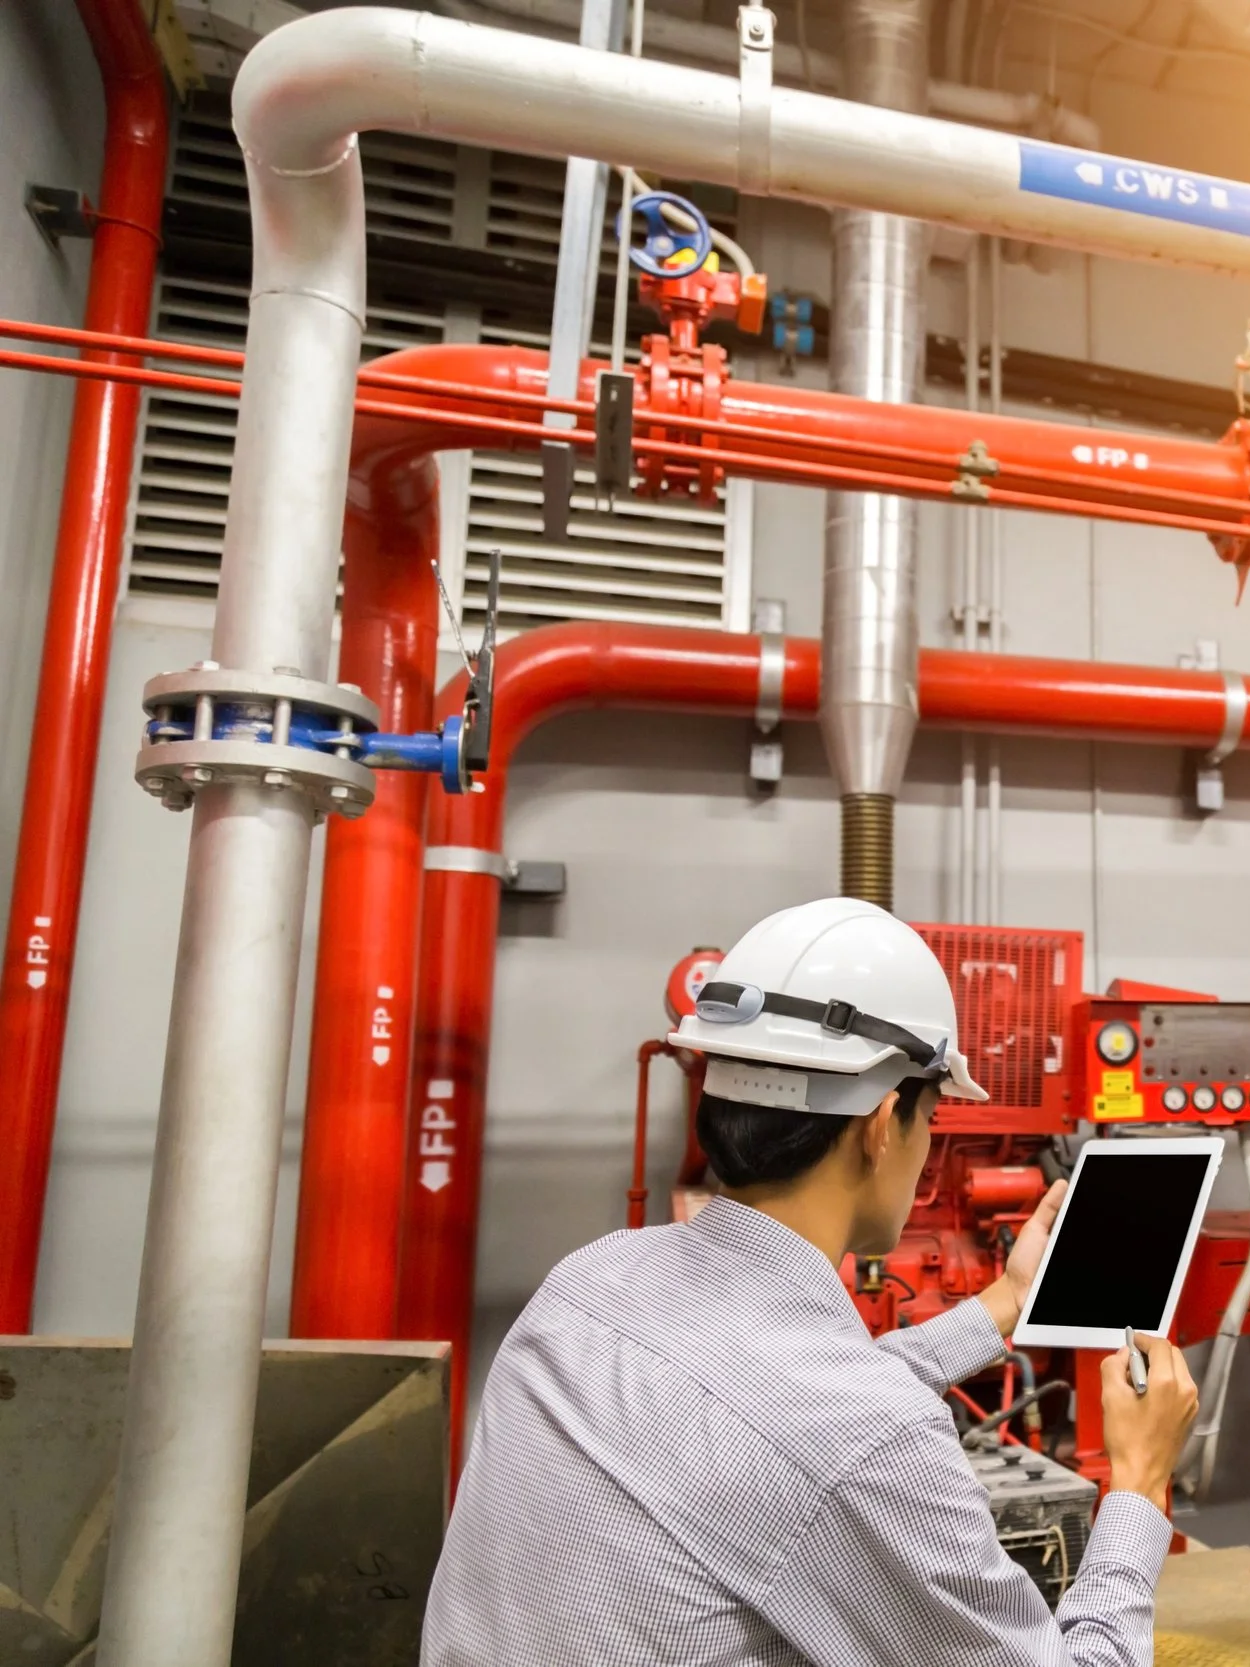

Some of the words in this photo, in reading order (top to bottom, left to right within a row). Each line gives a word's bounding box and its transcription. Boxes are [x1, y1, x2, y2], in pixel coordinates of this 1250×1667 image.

[1114, 168, 1199, 205] CWS
[1097, 446, 1128, 468] FP
[27, 935, 50, 964] FP
[372, 1007, 393, 1039] FP
[420, 1105, 457, 1155] FP
